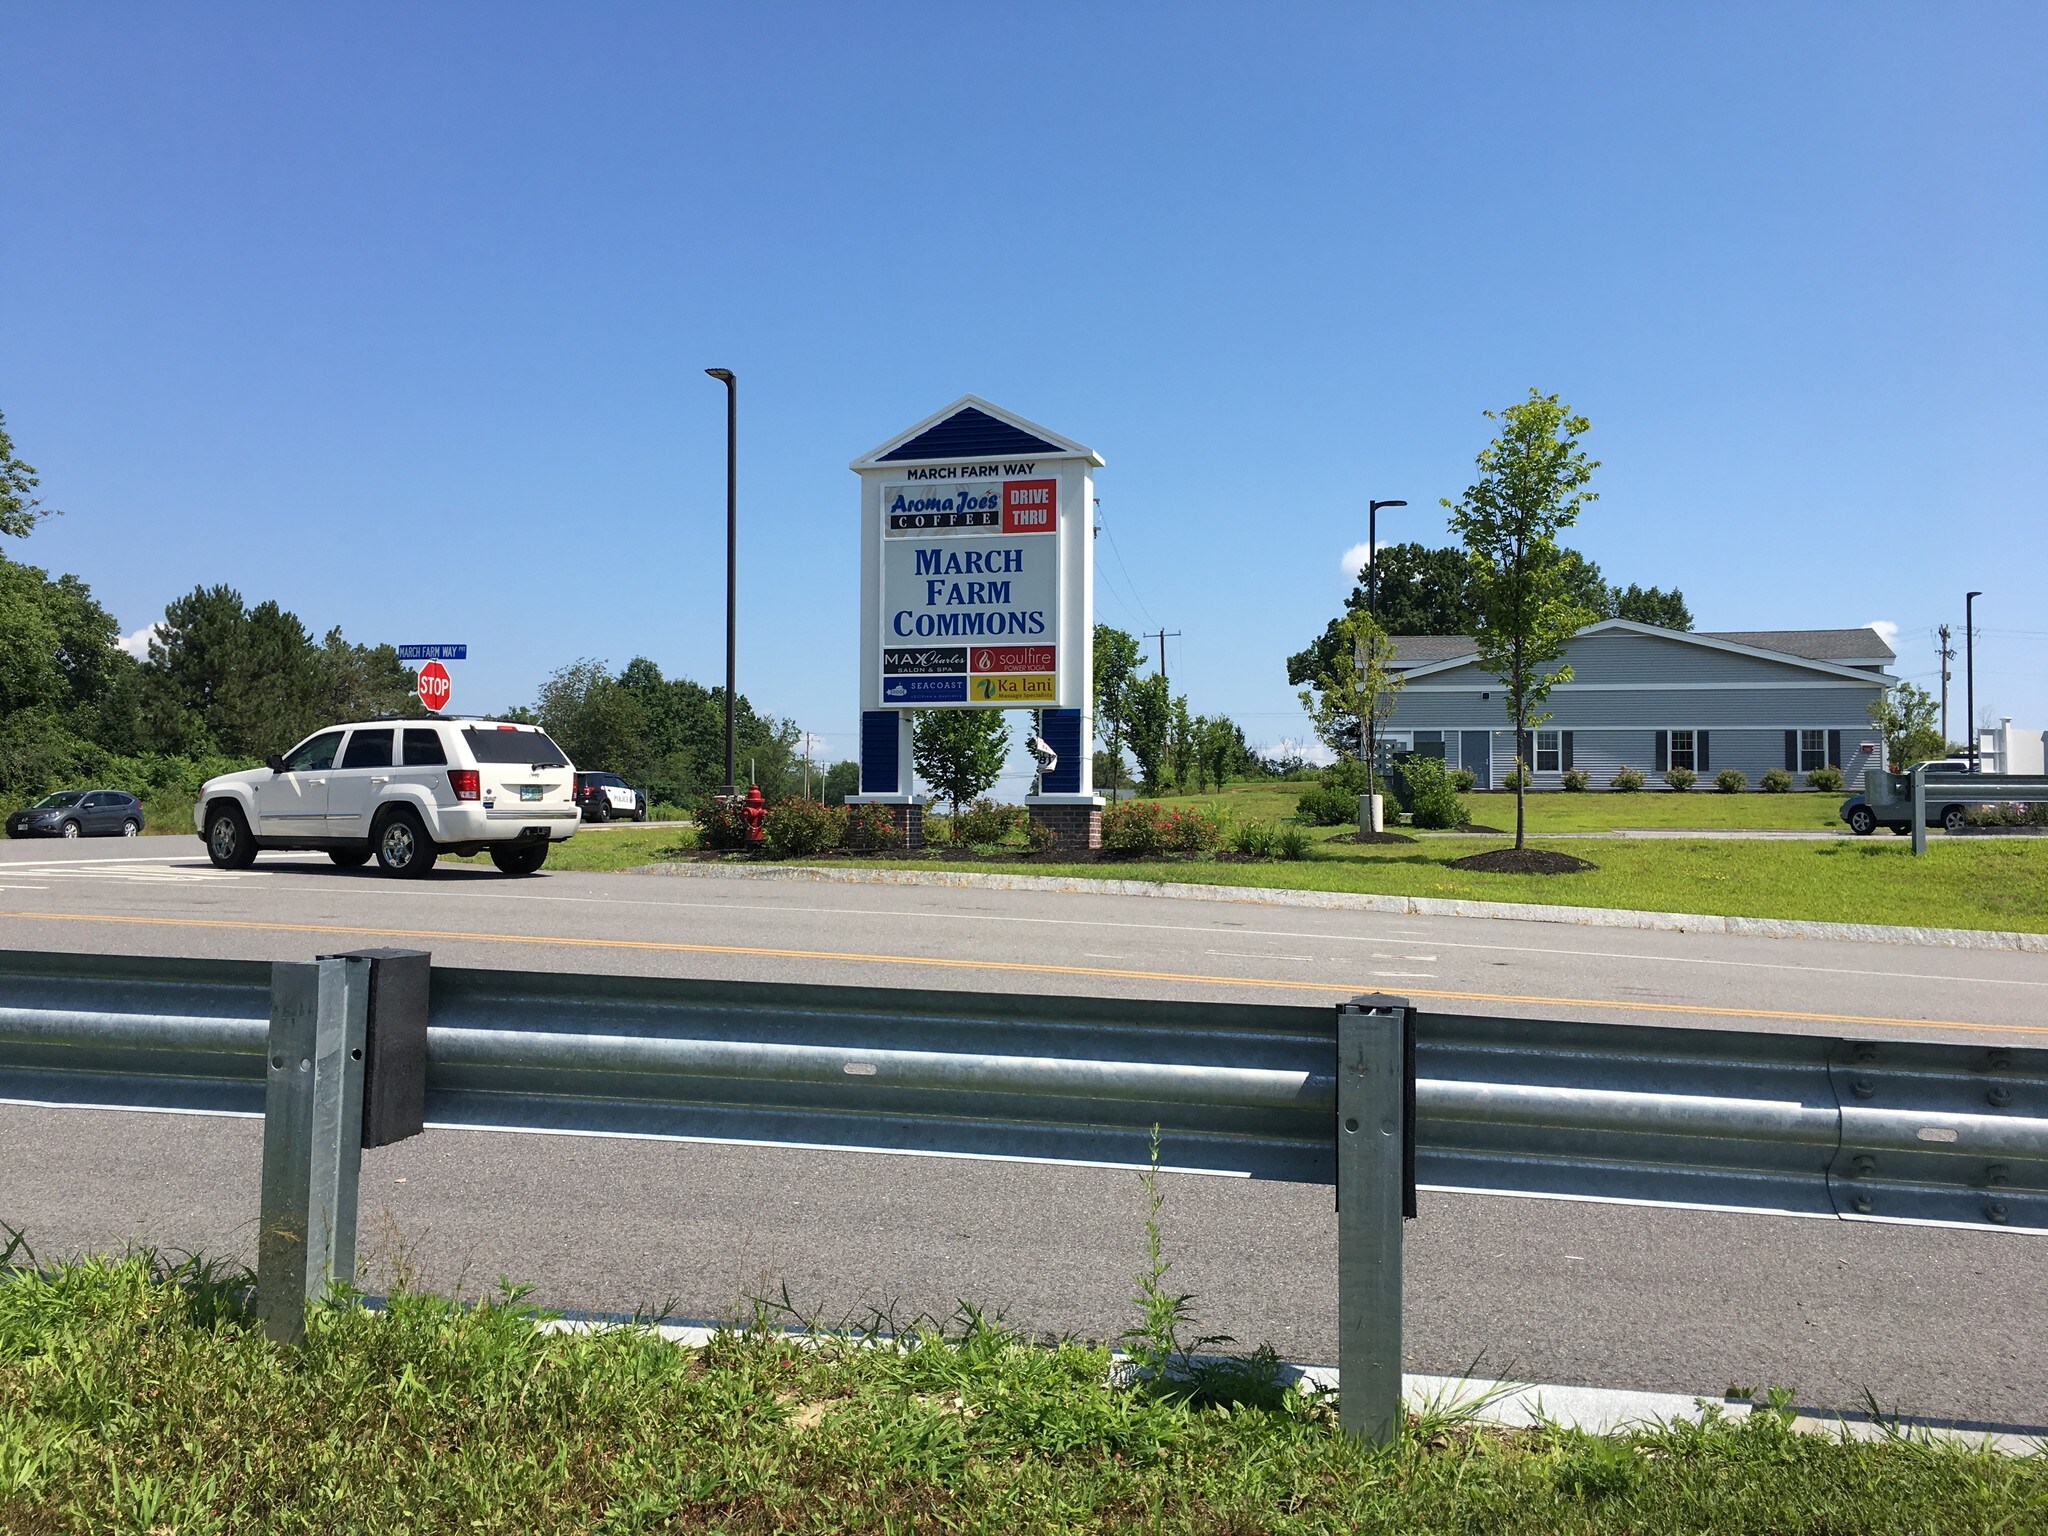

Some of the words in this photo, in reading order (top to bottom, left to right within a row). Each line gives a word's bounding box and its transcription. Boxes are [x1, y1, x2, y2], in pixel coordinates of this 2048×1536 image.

[908, 467, 957, 480] MARCH
[961, 465, 999, 478] FARM
[1003, 463, 1036, 476] WAY
[890, 494, 953, 513] Aroma
[1010, 488, 1049, 506] DRIVE
[898, 513, 991, 528] COFFEE
[1012, 509, 1048, 526] THRU
[914, 549, 1024, 576] MARCH
[926, 579, 1012, 606] FARM
[893, 610, 1046, 637] COMMONS
[399, 646, 420, 658] MARCH
[422, 646, 440, 658] FARM
[442, 646, 457, 658] WAY
[884, 653, 928, 665] MAX
[921, 650, 966, 667] Charles
[999, 647, 1052, 665] soulfire
[420, 675, 450, 697] STOP
[910, 681, 963, 690] SEACOAST
[997, 679, 1018, 692] Ka
